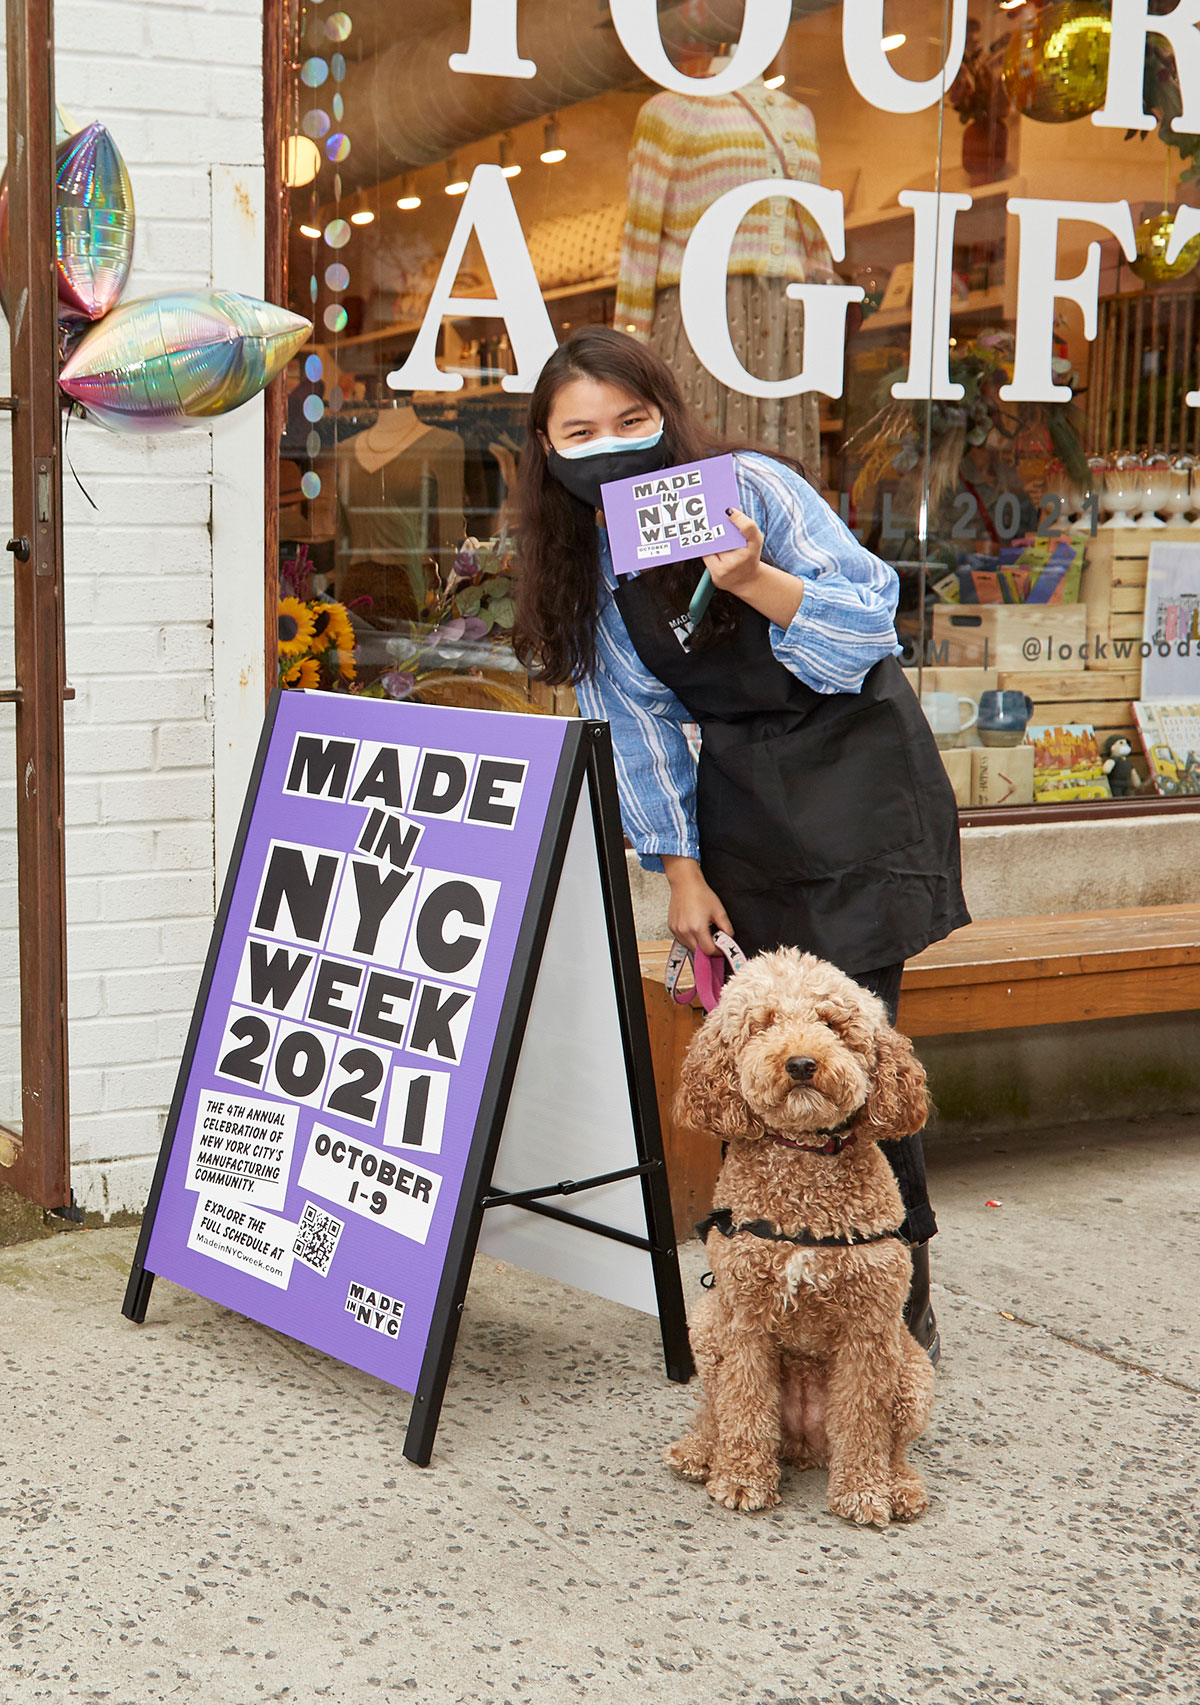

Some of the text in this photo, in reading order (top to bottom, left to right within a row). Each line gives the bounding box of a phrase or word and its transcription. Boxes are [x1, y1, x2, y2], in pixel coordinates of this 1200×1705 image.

[386, 164, 1200, 407] A GIF
[634, 472, 700, 498] MADE
[662, 493, 677, 502] IN
[638, 498, 703, 528] NYC
[642, 516, 706, 542] WEEK
[951, 492, 1099, 539] 2021
[681, 527, 721, 546] 2021
[287, 736, 525, 825] MADE
[358, 808, 421, 870] IN
[255, 845, 486, 973] NYC
[250, 941, 471, 1060] WEEK
[219, 1015, 432, 1146] 2021
[203, 1117, 284, 1143] CELEBRATION OF
[207, 1100, 285, 1126] THE 4TH ANNUAL
[200, 1134, 284, 1161] NEW YORK CITY'S
[195, 1168, 255, 1192] COMMUNITY.
[197, 1151, 280, 1179] MANUFACTURING
[315, 1133, 433, 1204] OCTOBER
[348, 1181, 388, 1215] 1-9
[204, 1200, 266, 1233] EXPLORE THE
[196, 1233, 283, 1277] MadeinNYCweek.com
[201, 1216, 285, 1260] FULL SCHEDULE AT
[350, 1283, 403, 1317] MADE
[347, 1300, 399, 1336] IN NYC
